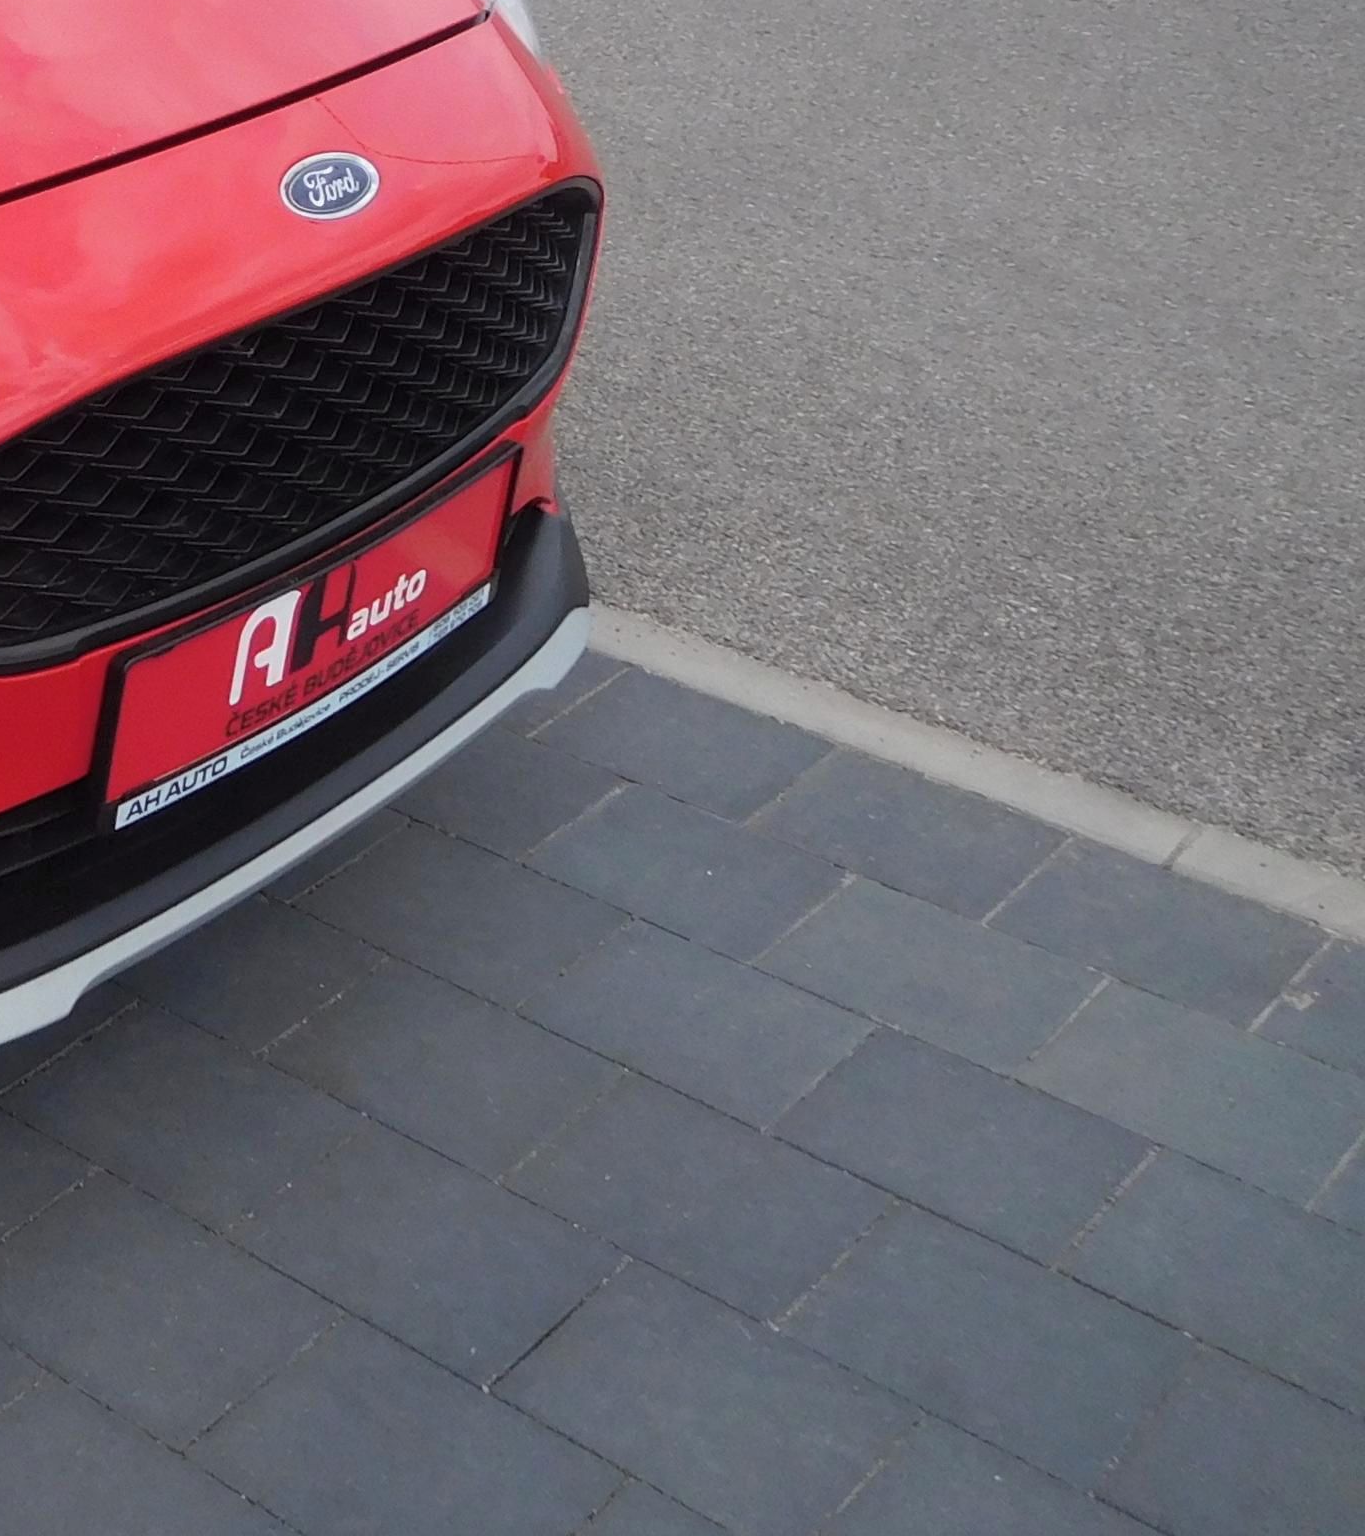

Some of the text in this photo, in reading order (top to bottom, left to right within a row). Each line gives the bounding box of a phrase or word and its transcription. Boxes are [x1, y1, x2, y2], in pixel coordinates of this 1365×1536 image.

[303, 166, 360, 207] Ford
[346, 569, 427, 641] auto
[226, 682, 298, 738] ČESKÉ
[125, 790, 162, 821] AH
[165, 755, 228, 802] AUTO
